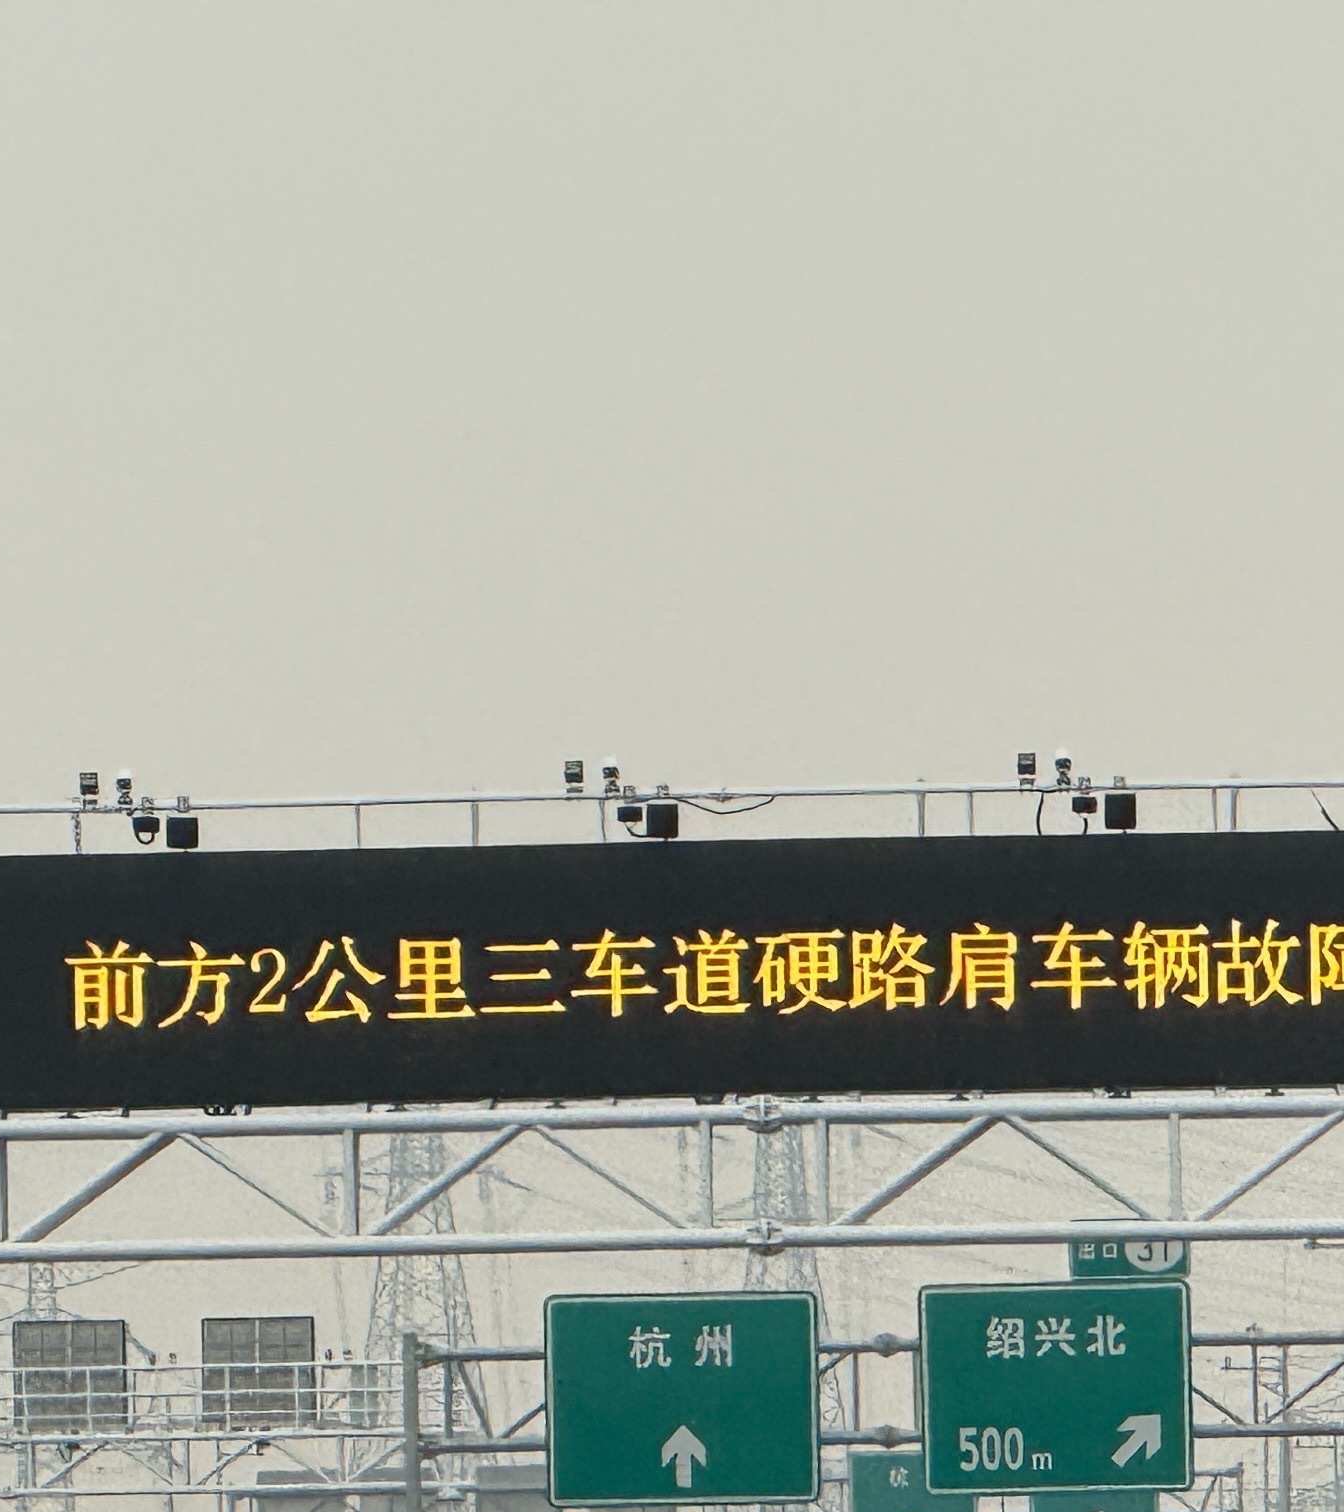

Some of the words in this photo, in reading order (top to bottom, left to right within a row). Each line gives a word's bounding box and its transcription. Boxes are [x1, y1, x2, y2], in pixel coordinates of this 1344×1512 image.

[628, 1325, 734, 1370] 杭州
[986, 1315, 1127, 1359] 绍兴北
